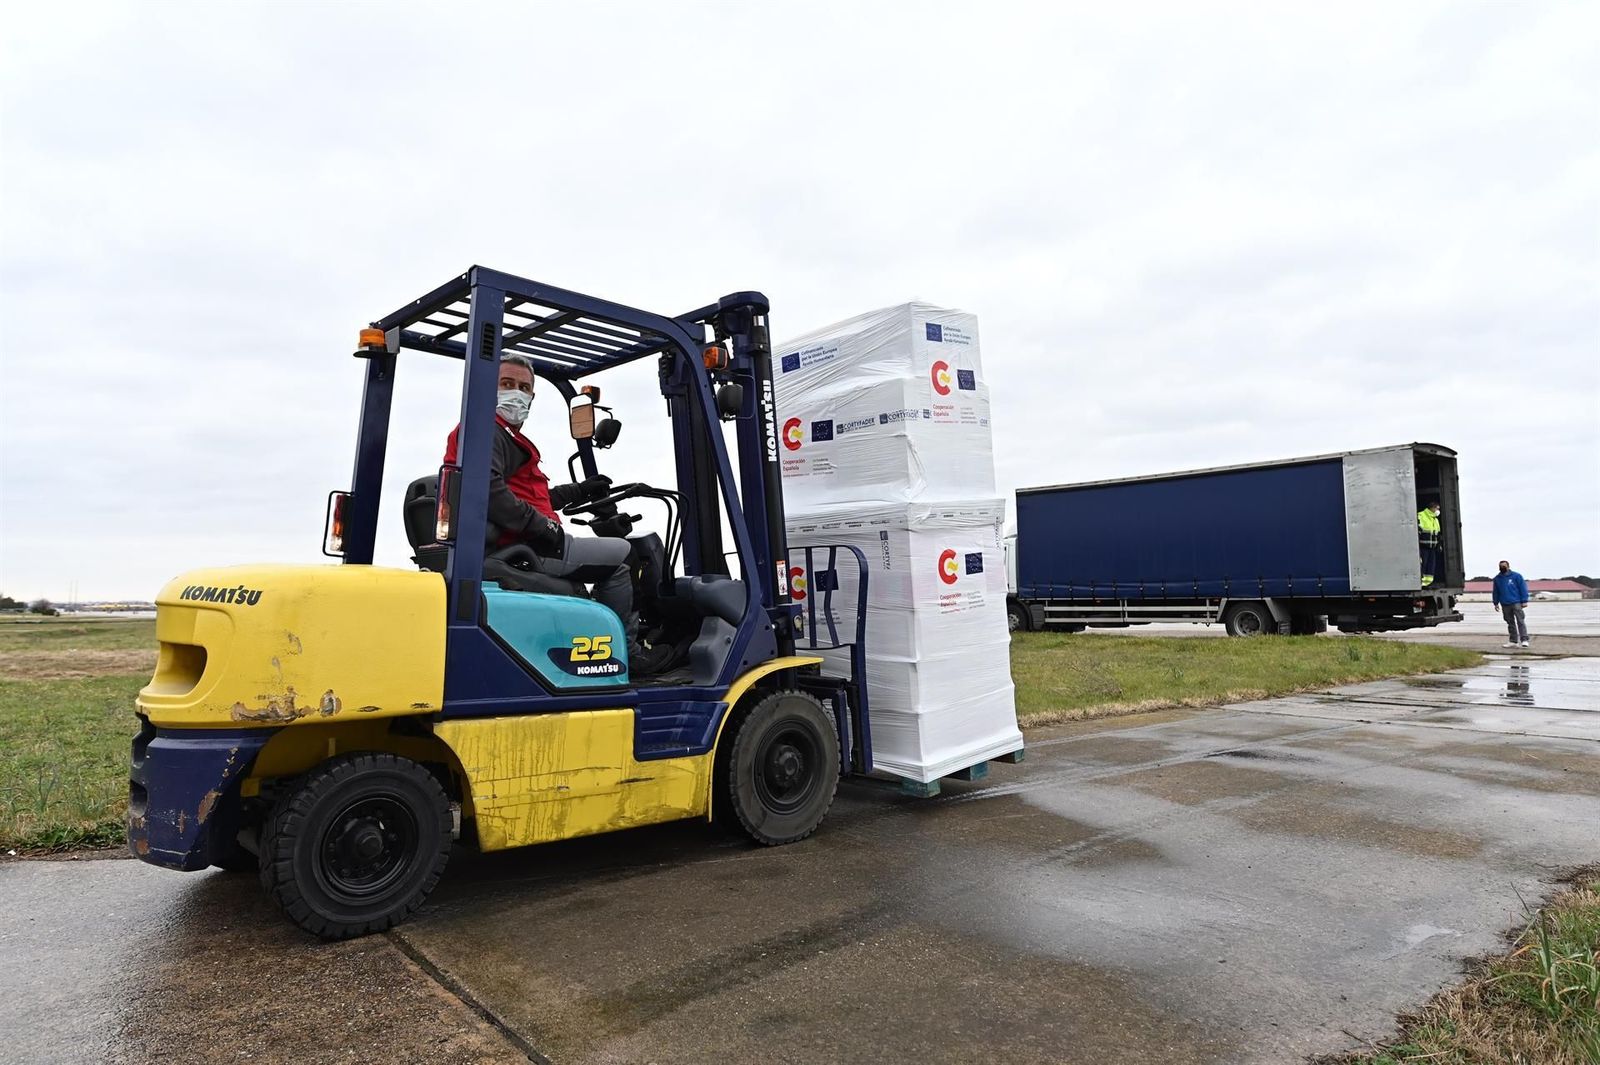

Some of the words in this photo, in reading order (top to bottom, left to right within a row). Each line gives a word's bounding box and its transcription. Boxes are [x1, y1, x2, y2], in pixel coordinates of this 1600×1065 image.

[761, 379, 777, 461] KOMATSU
[180, 584, 263, 606] KOMATSU
[570, 635, 613, 662] 25
[577, 663, 618, 675] KOMATSU
